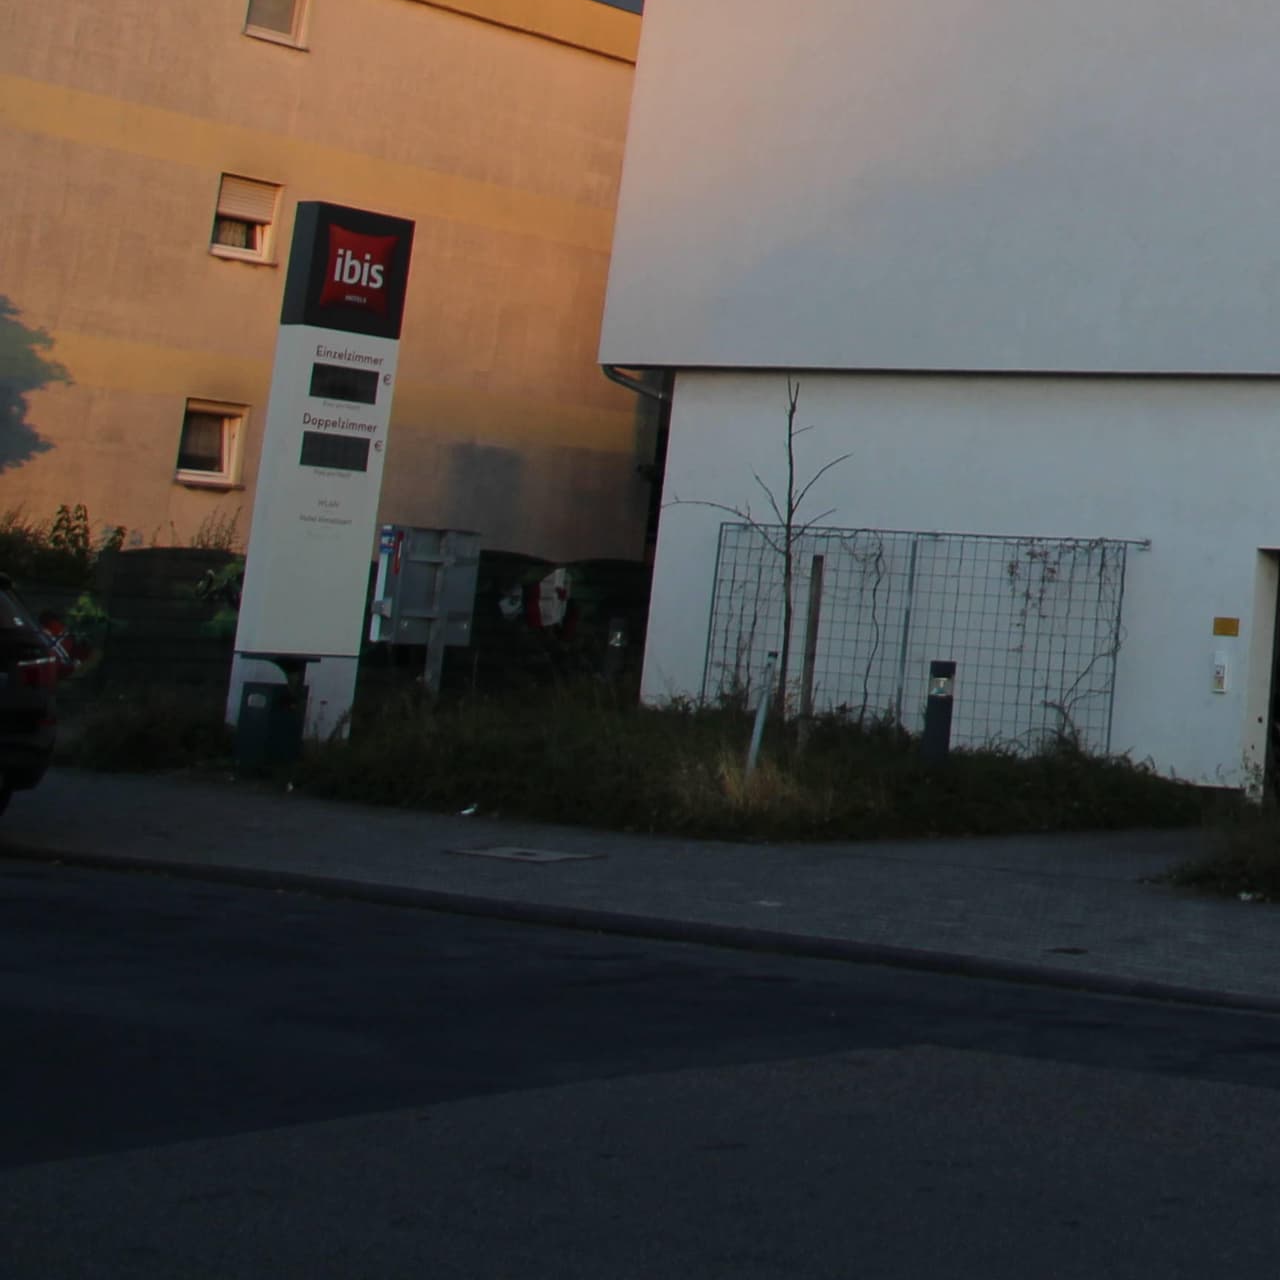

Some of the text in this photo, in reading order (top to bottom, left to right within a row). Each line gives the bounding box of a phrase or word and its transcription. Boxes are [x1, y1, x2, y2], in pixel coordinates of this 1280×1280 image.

[334, 248, 384, 289] ibis
[315, 344, 384, 366] Einzelzimmer
[302, 412, 378, 433] Doppelzimmer
[374, 440, 384, 452] €
